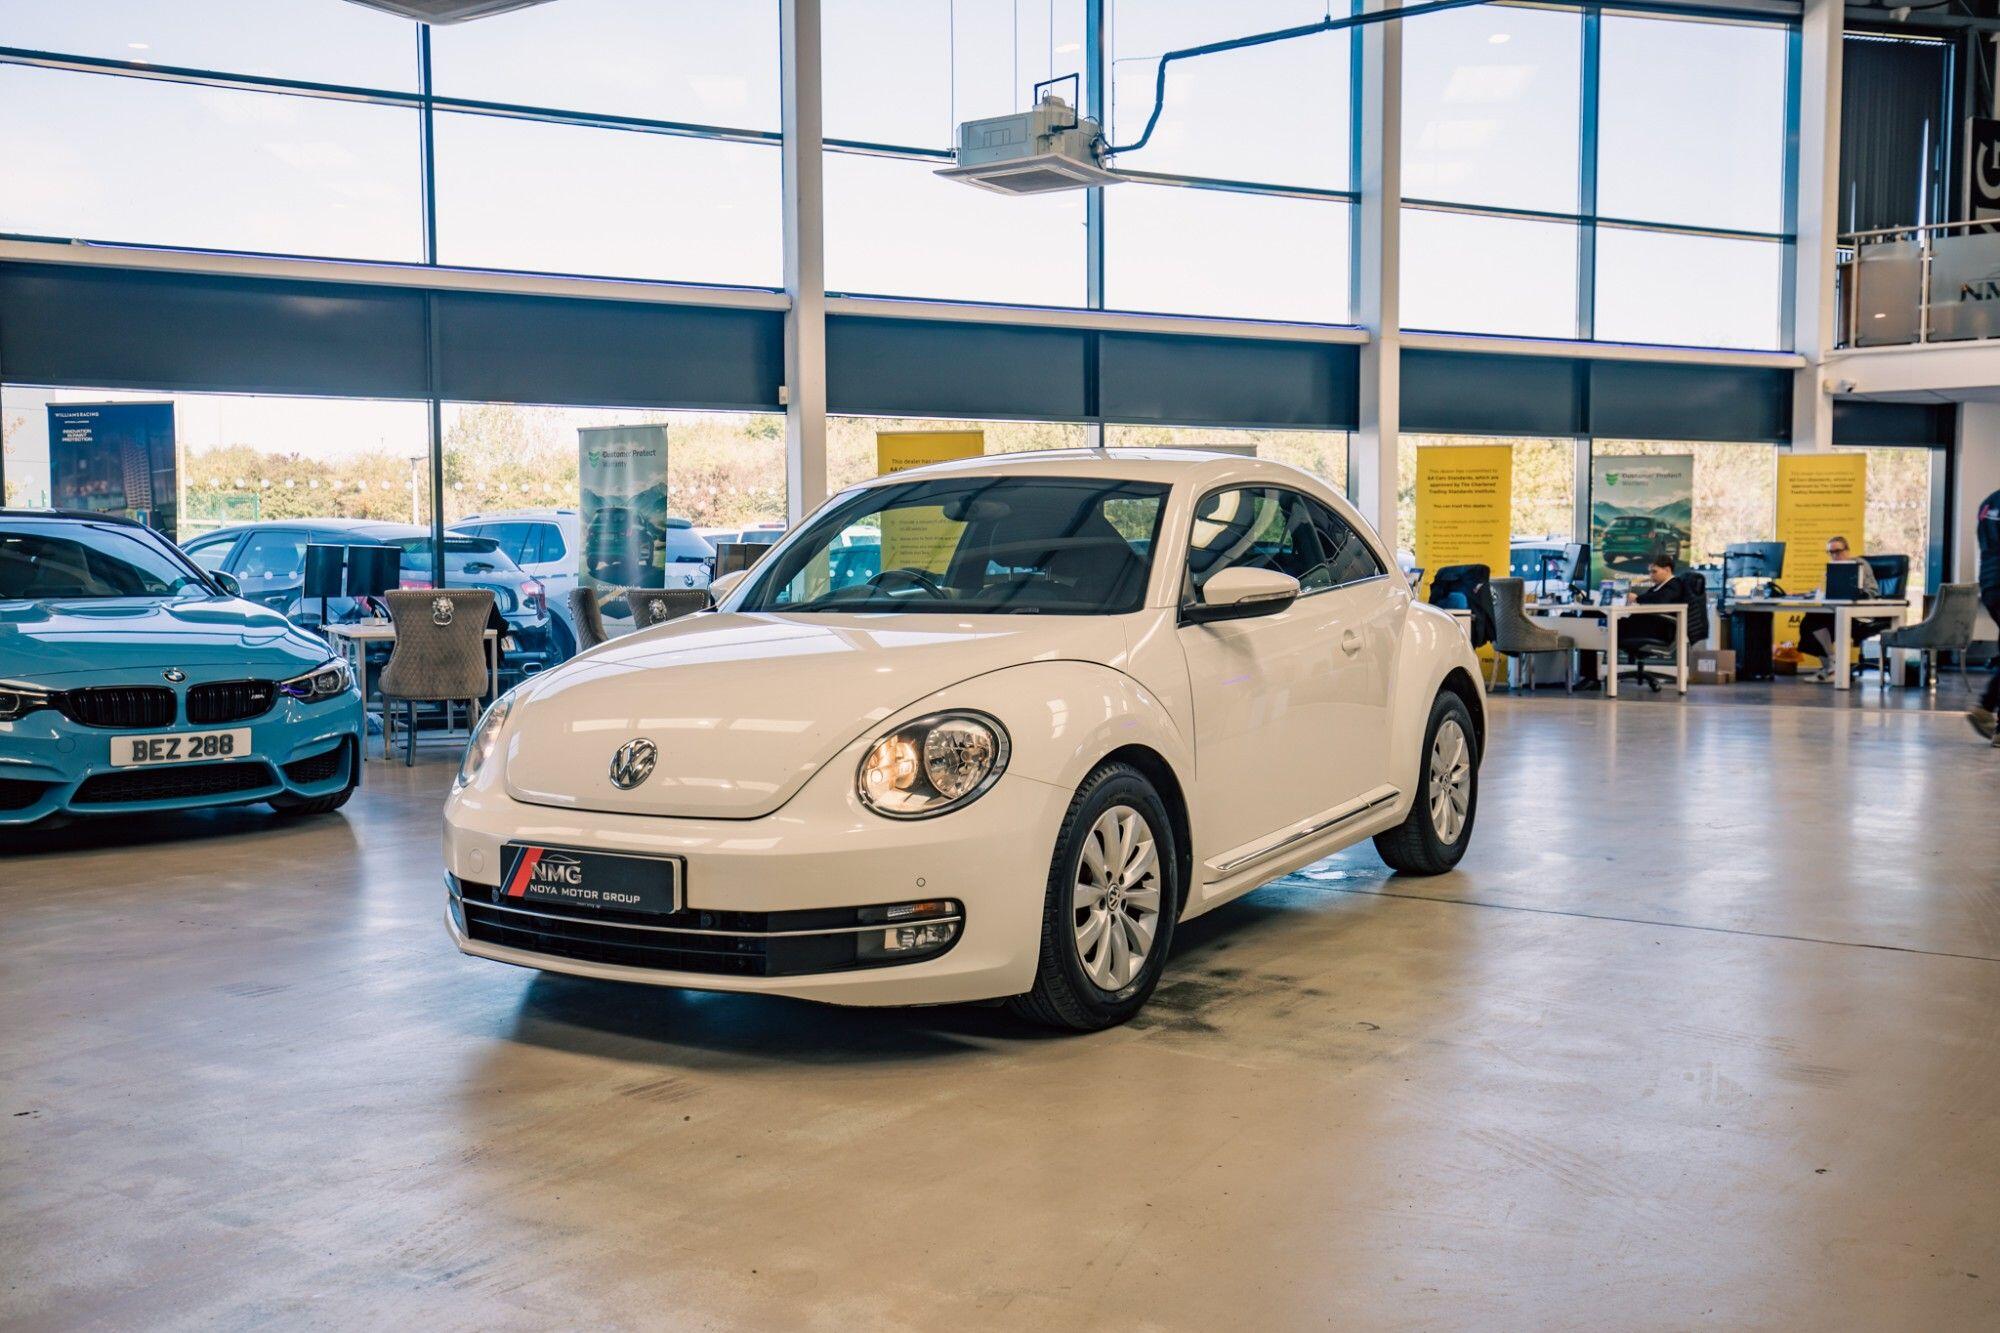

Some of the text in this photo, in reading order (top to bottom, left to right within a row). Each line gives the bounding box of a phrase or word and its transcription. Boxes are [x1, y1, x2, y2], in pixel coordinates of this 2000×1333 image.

[632, 449, 656, 457] Protect
[132, 733, 234, 762] BEZ 288
[530, 861, 582, 885] NMG
[530, 884, 641, 904] NOYA MOTOR GROUP
